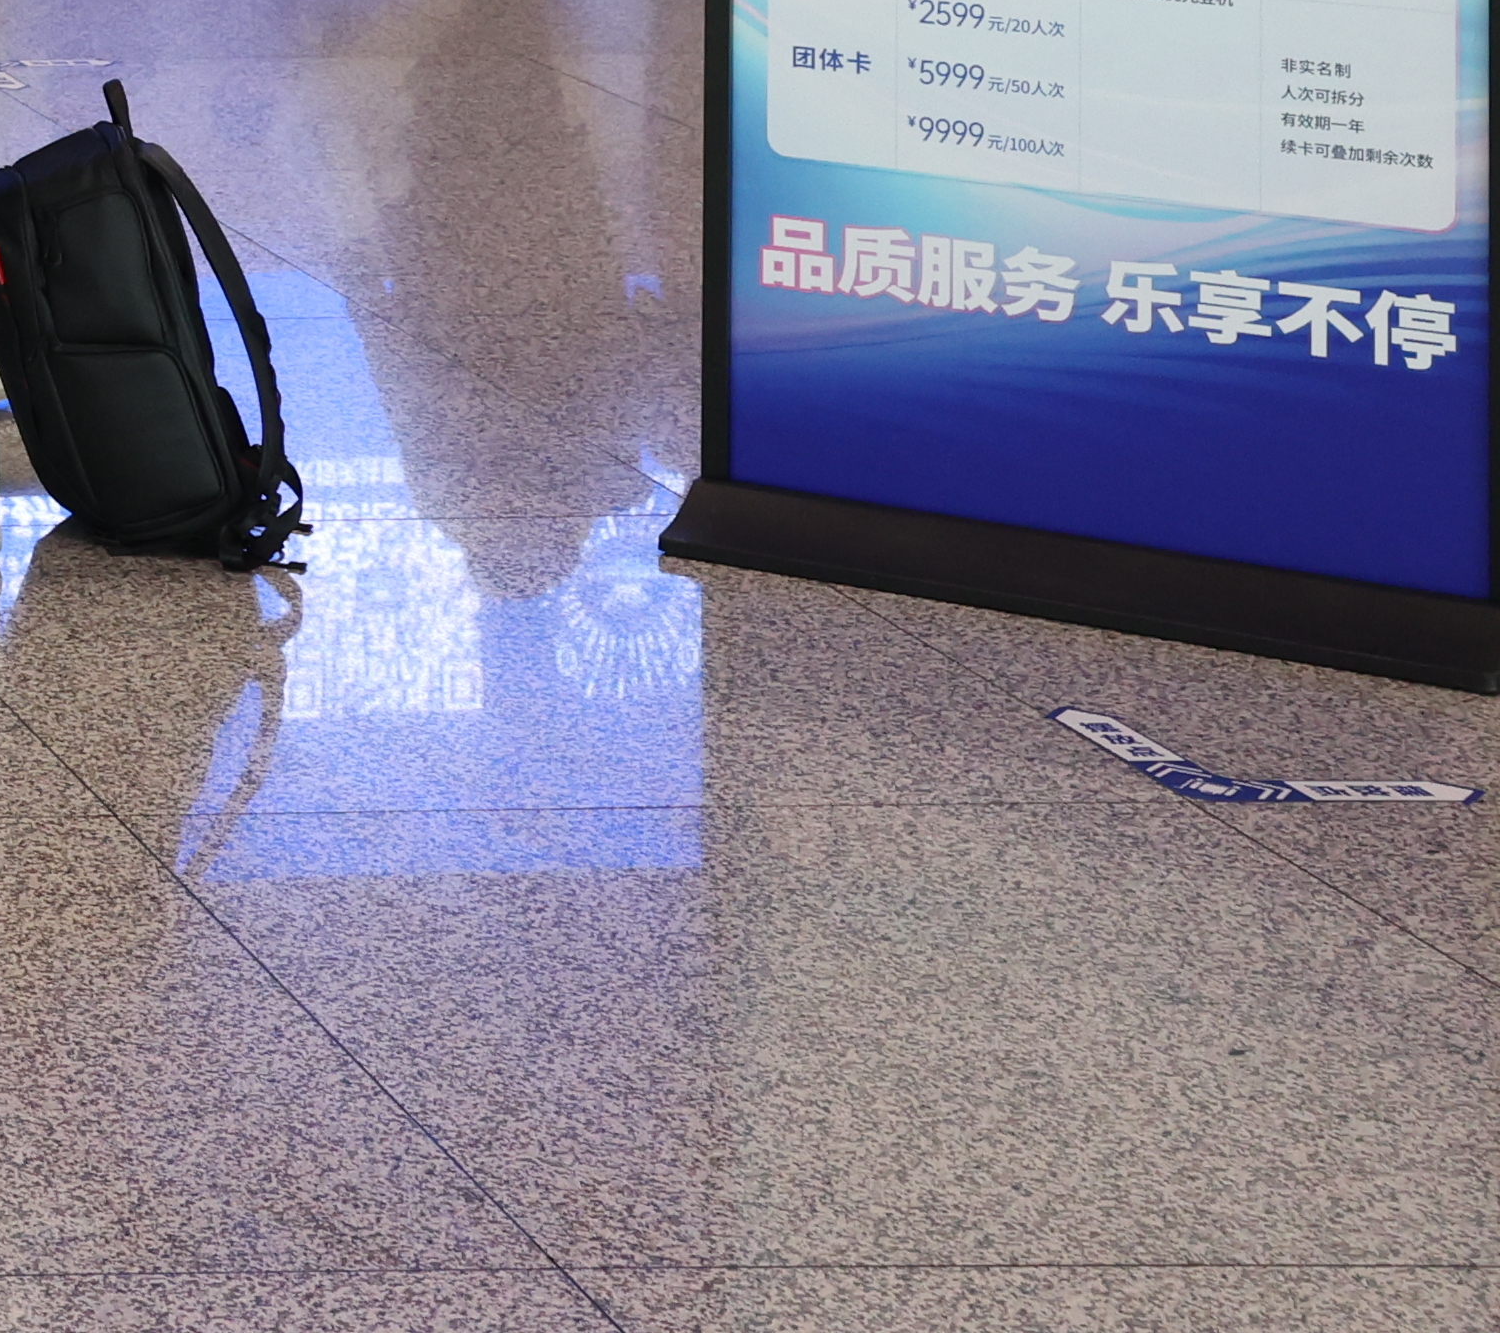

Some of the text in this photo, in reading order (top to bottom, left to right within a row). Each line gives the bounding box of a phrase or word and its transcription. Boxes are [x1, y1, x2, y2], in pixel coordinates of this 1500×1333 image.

[791, 44, 873, 76] 团体卡
[1280, 56, 1353, 81] 非实名制
[1280, 84, 1365, 109] 人次可拆分
[1280, 110, 1366, 135] 有效期一年
[1279, 137, 1435, 171] 续卡可叠加剩余次数
[760, 212, 1459, 372] 品质服务 乐享不停
